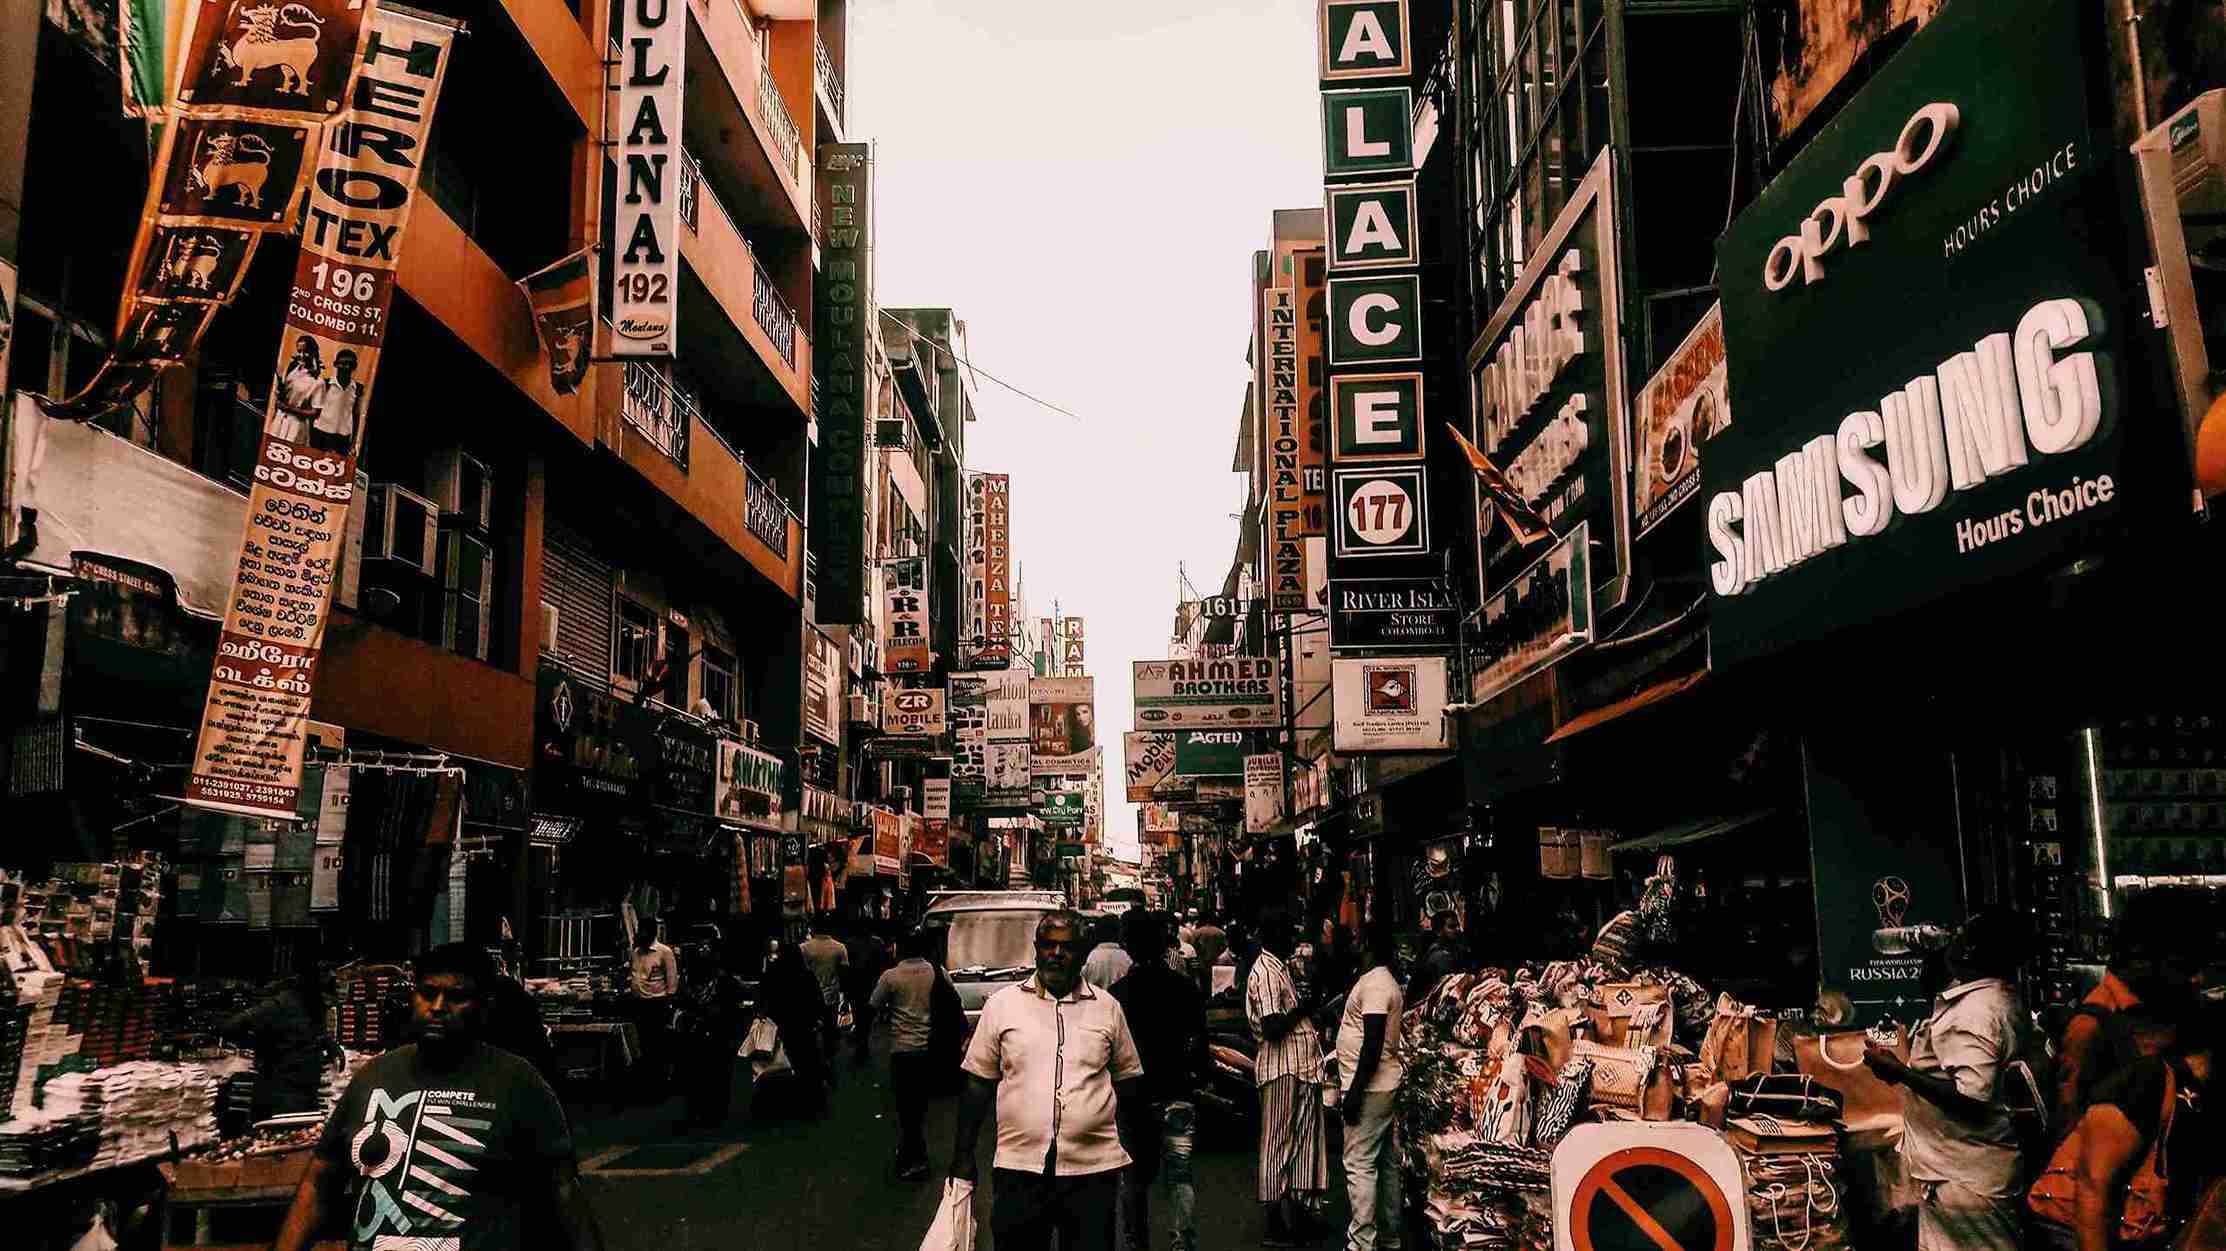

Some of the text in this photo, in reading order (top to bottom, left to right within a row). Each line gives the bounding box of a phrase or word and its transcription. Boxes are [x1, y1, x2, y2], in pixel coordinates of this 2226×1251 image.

[316, 30, 441, 211] HERO
[827, 184, 860, 248] NEW
[1943, 142, 2077, 259] HOURS CHOICE
[309, 208, 399, 262] TEX
[312, 262, 375, 302] 196
[618, 273, 668, 304] 192
[289, 303, 357, 333] COLOMBO
[313, 295, 361, 316] CROSS
[1272, 292, 1299, 502] INTERNATIONAL
[1708, 298, 2101, 596] SAMSUNG
[1352, 494, 1407, 533] 177
[1955, 472, 2115, 554] Hours Choice
[1276, 510, 1302, 591] PLAZA
[1343, 590, 1403, 609] RIVER
[1391, 613, 1435, 626] STORE
[1168, 660, 1273, 681] AHMED
[899, 695, 929, 708] ZR
[1173, 680, 1270, 695] BROTHERS
[888, 713, 941, 725] MOBILE
[1850, 967, 1909, 982] RUSSIA
[428, 1090, 476, 1101] COMPETE
